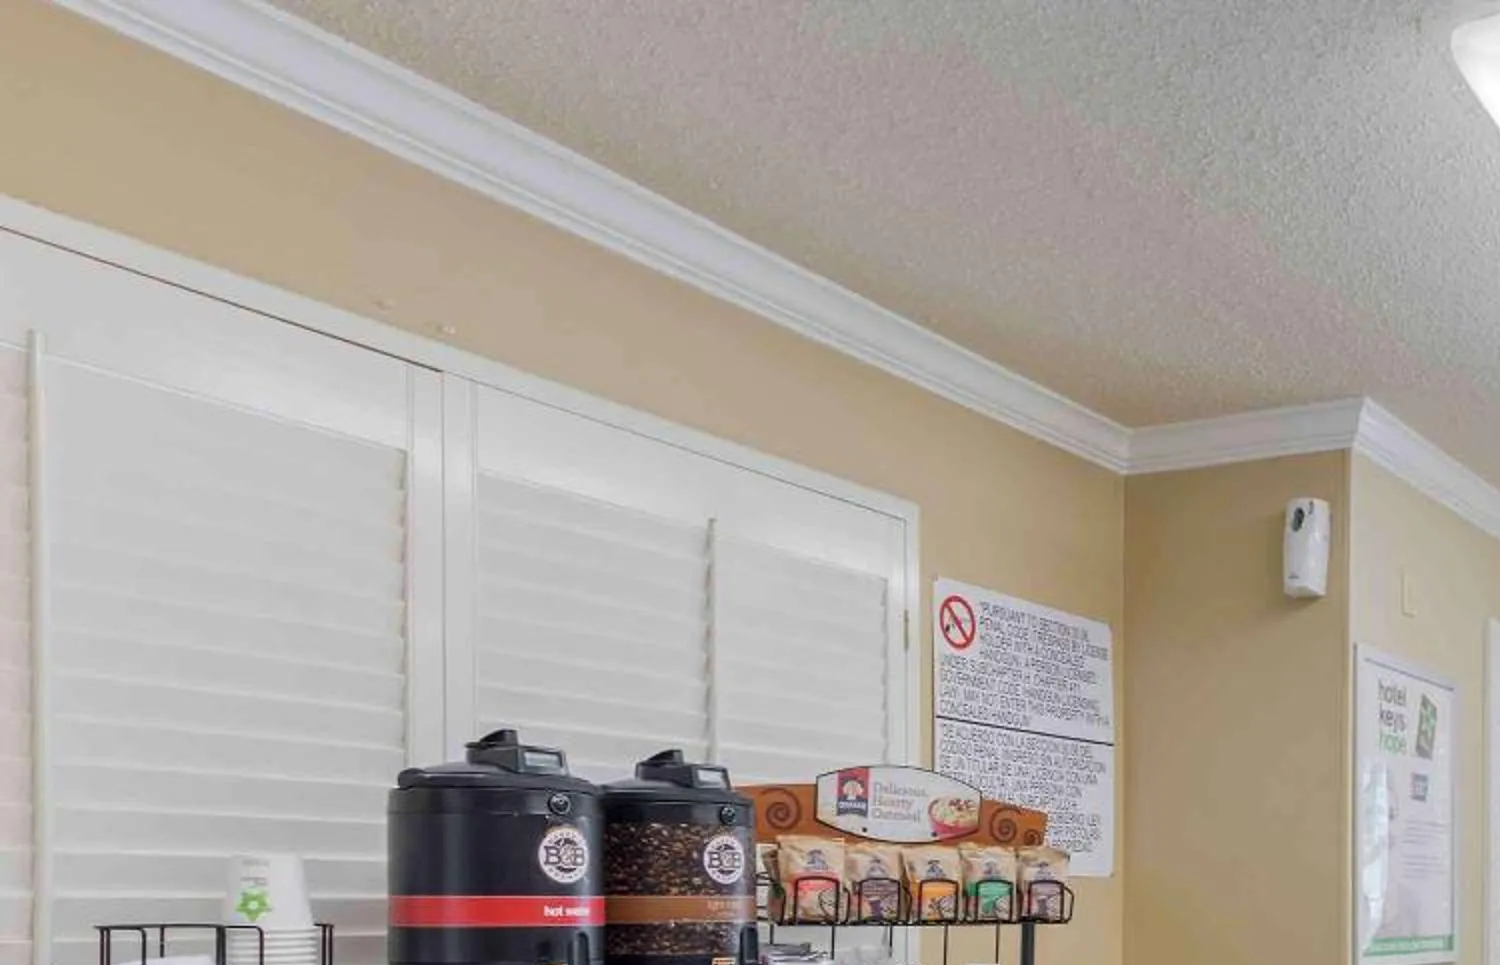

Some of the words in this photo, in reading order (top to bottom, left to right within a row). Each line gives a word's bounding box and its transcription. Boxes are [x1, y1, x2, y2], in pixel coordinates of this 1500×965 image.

[1378, 680, 1406, 707] hotel
[1378, 702, 1406, 733] keys
[543, 904, 564, 917] hot
